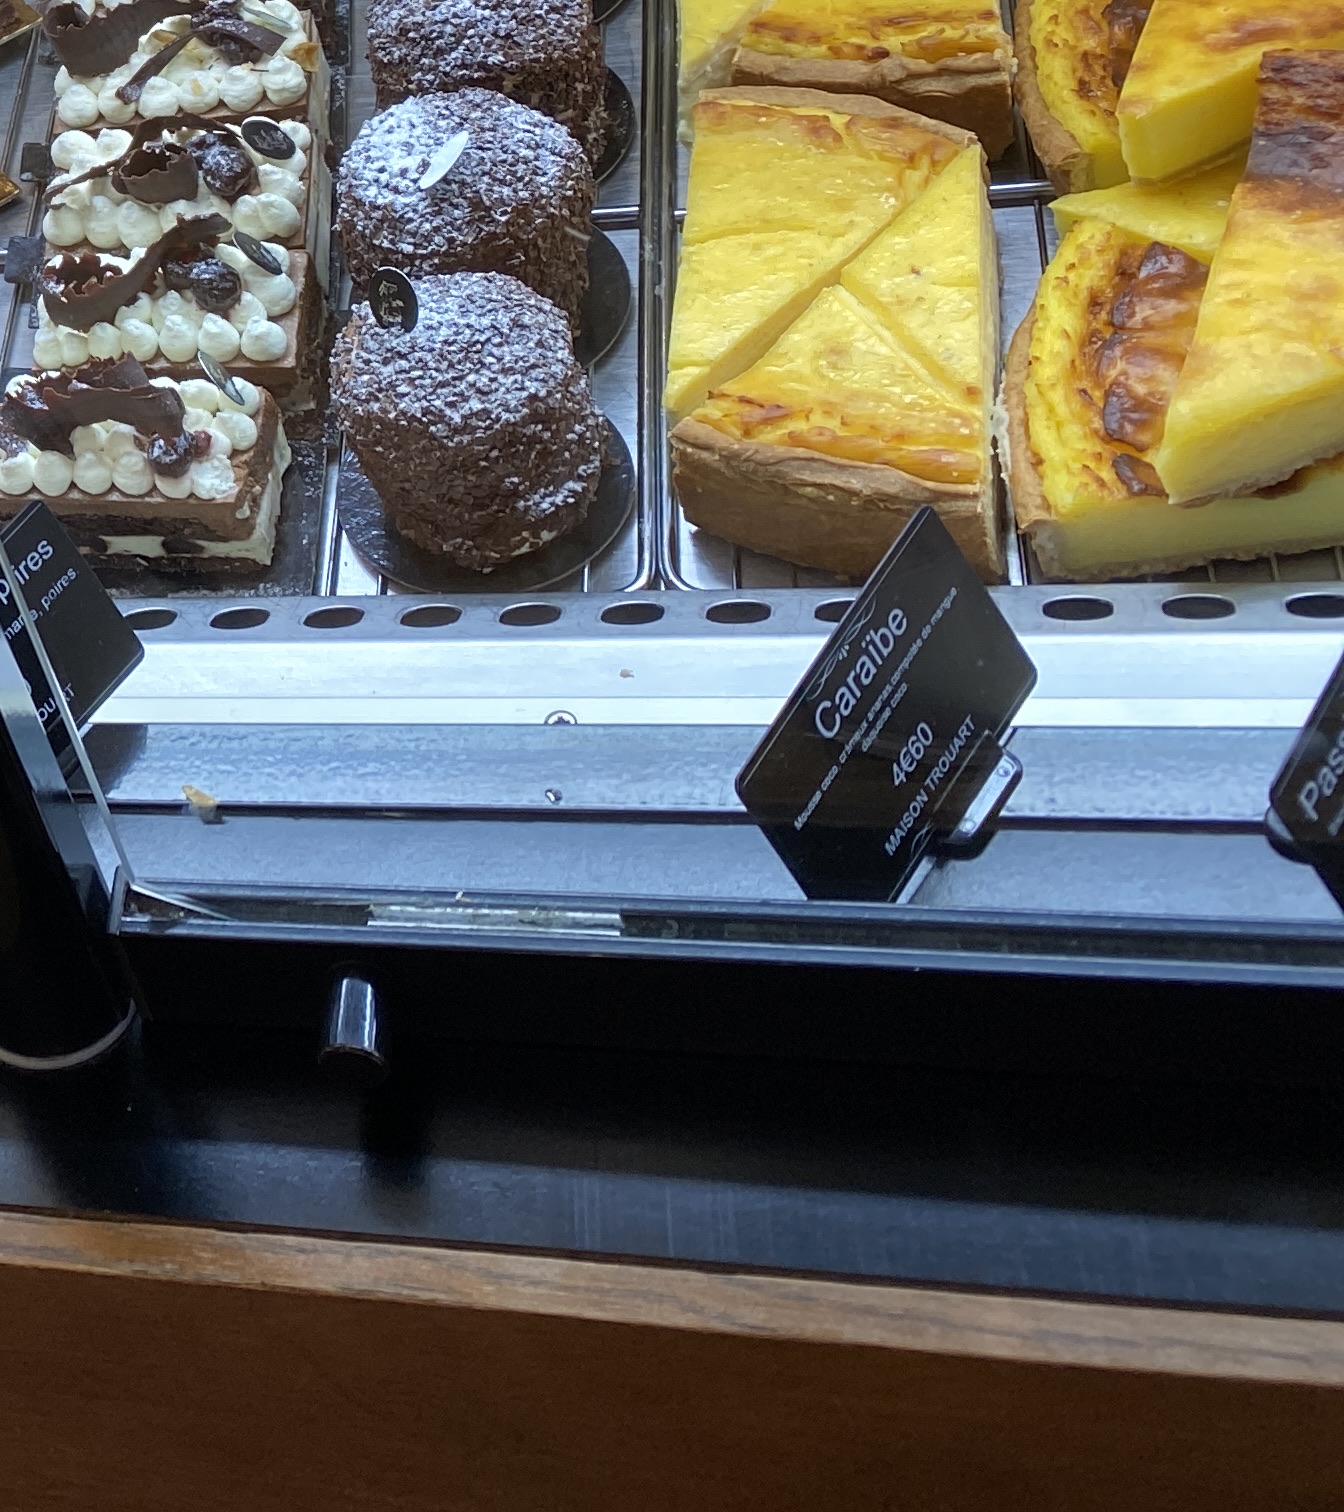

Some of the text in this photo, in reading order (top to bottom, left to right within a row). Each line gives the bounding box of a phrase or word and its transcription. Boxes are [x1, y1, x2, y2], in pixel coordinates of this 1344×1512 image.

[814, 607, 909, 741] Caraïbe
[883, 713, 976, 857] MAISON TROUART
[892, 722, 934, 788] 4€60
